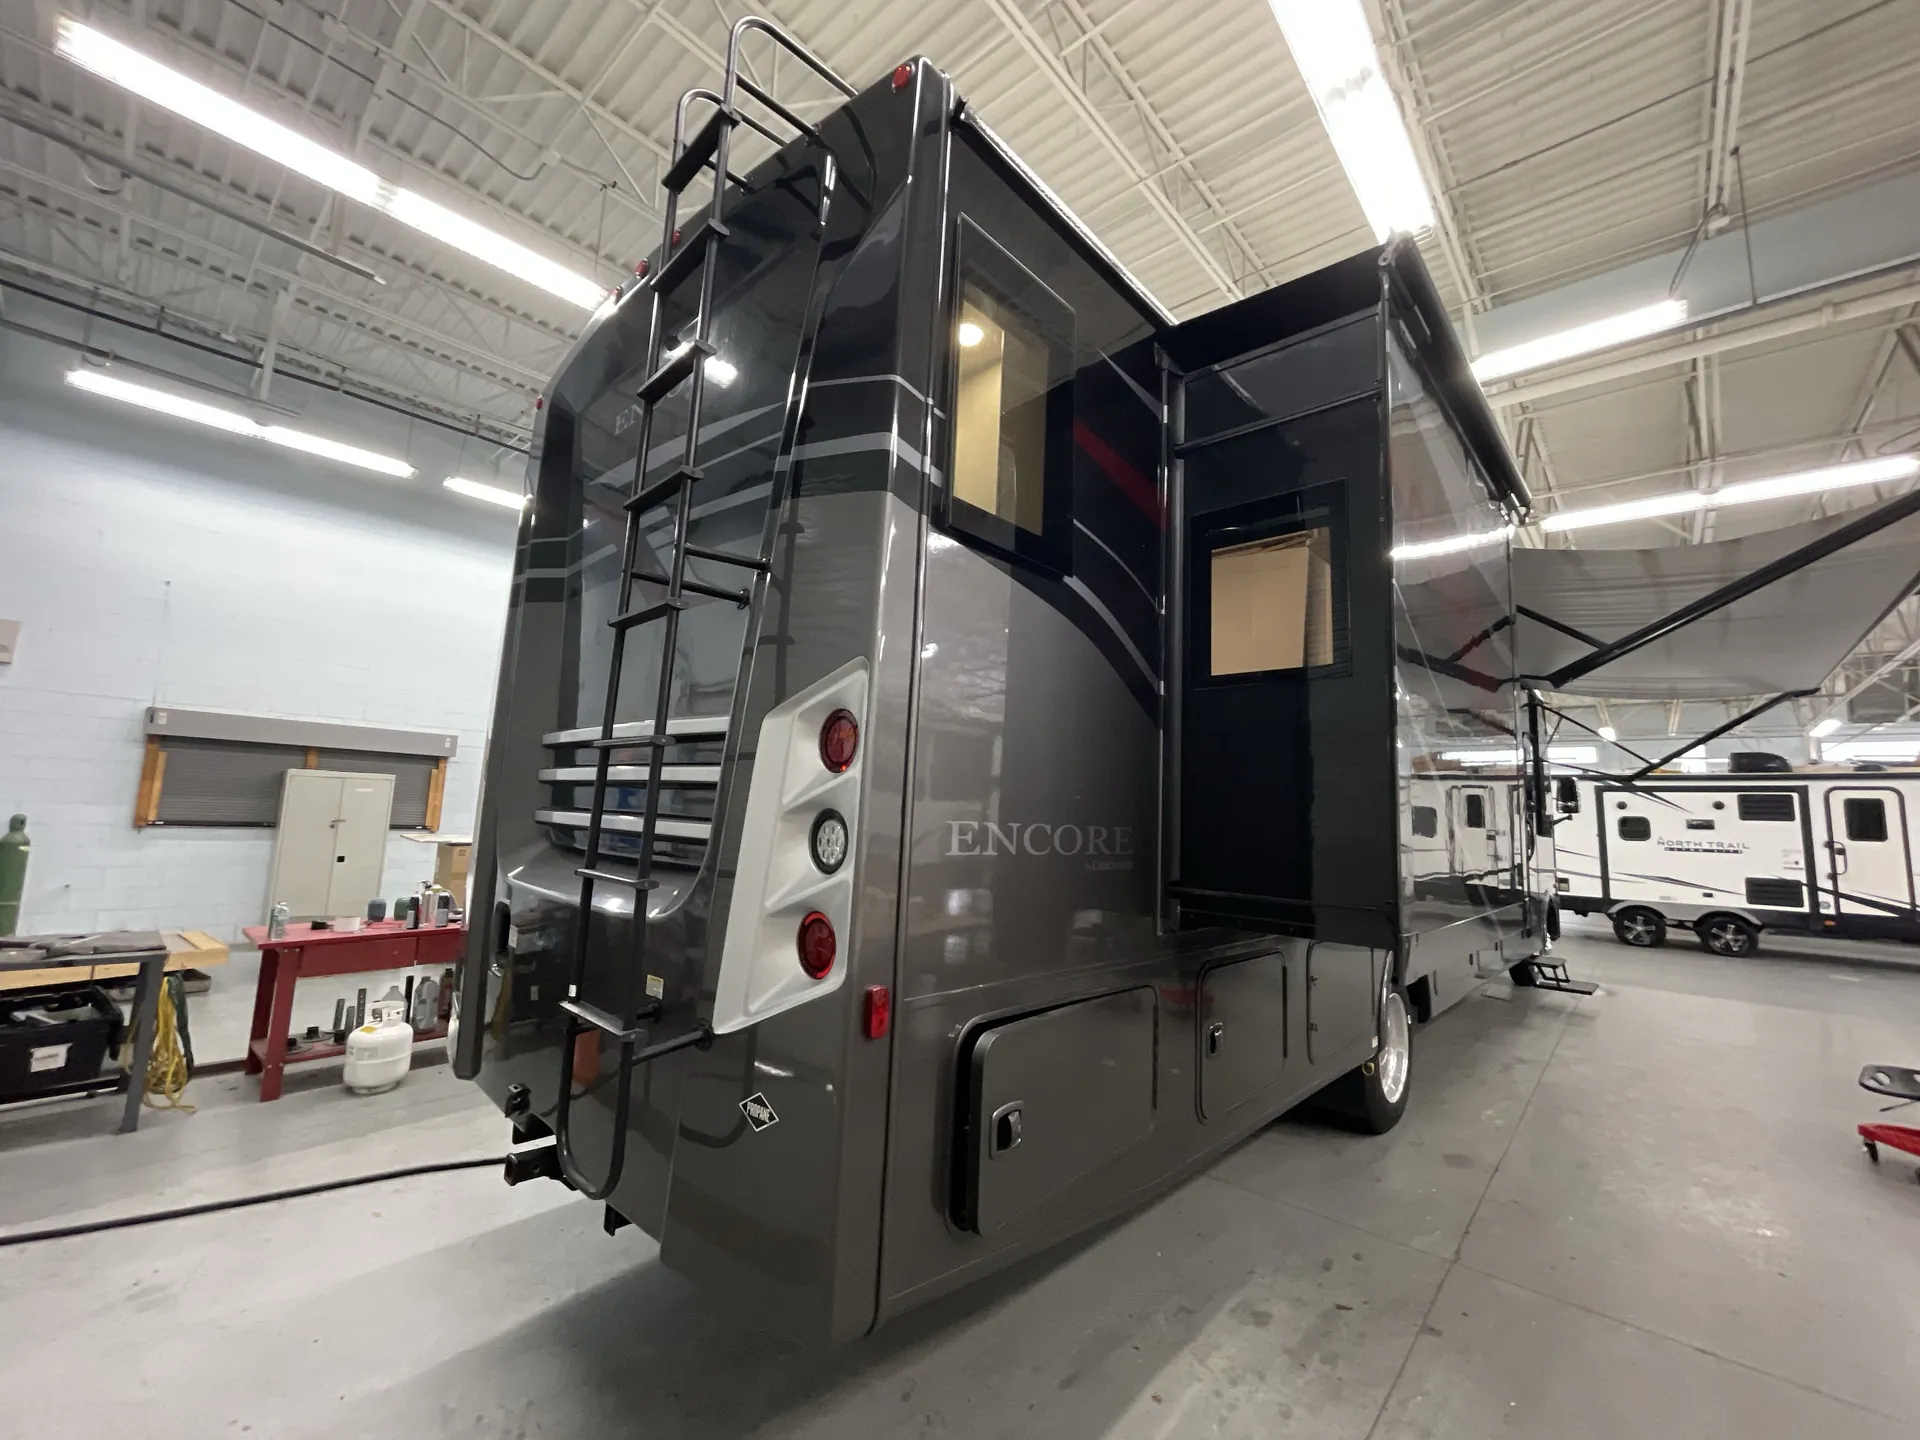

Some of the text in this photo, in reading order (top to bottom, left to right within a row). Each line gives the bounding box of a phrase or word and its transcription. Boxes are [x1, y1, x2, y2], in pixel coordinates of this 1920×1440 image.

[944, 820, 1133, 856] ENCORE
[1657, 838, 1750, 850] NORTH TRAIL
[746, 1101, 770, 1123] PROPANE
